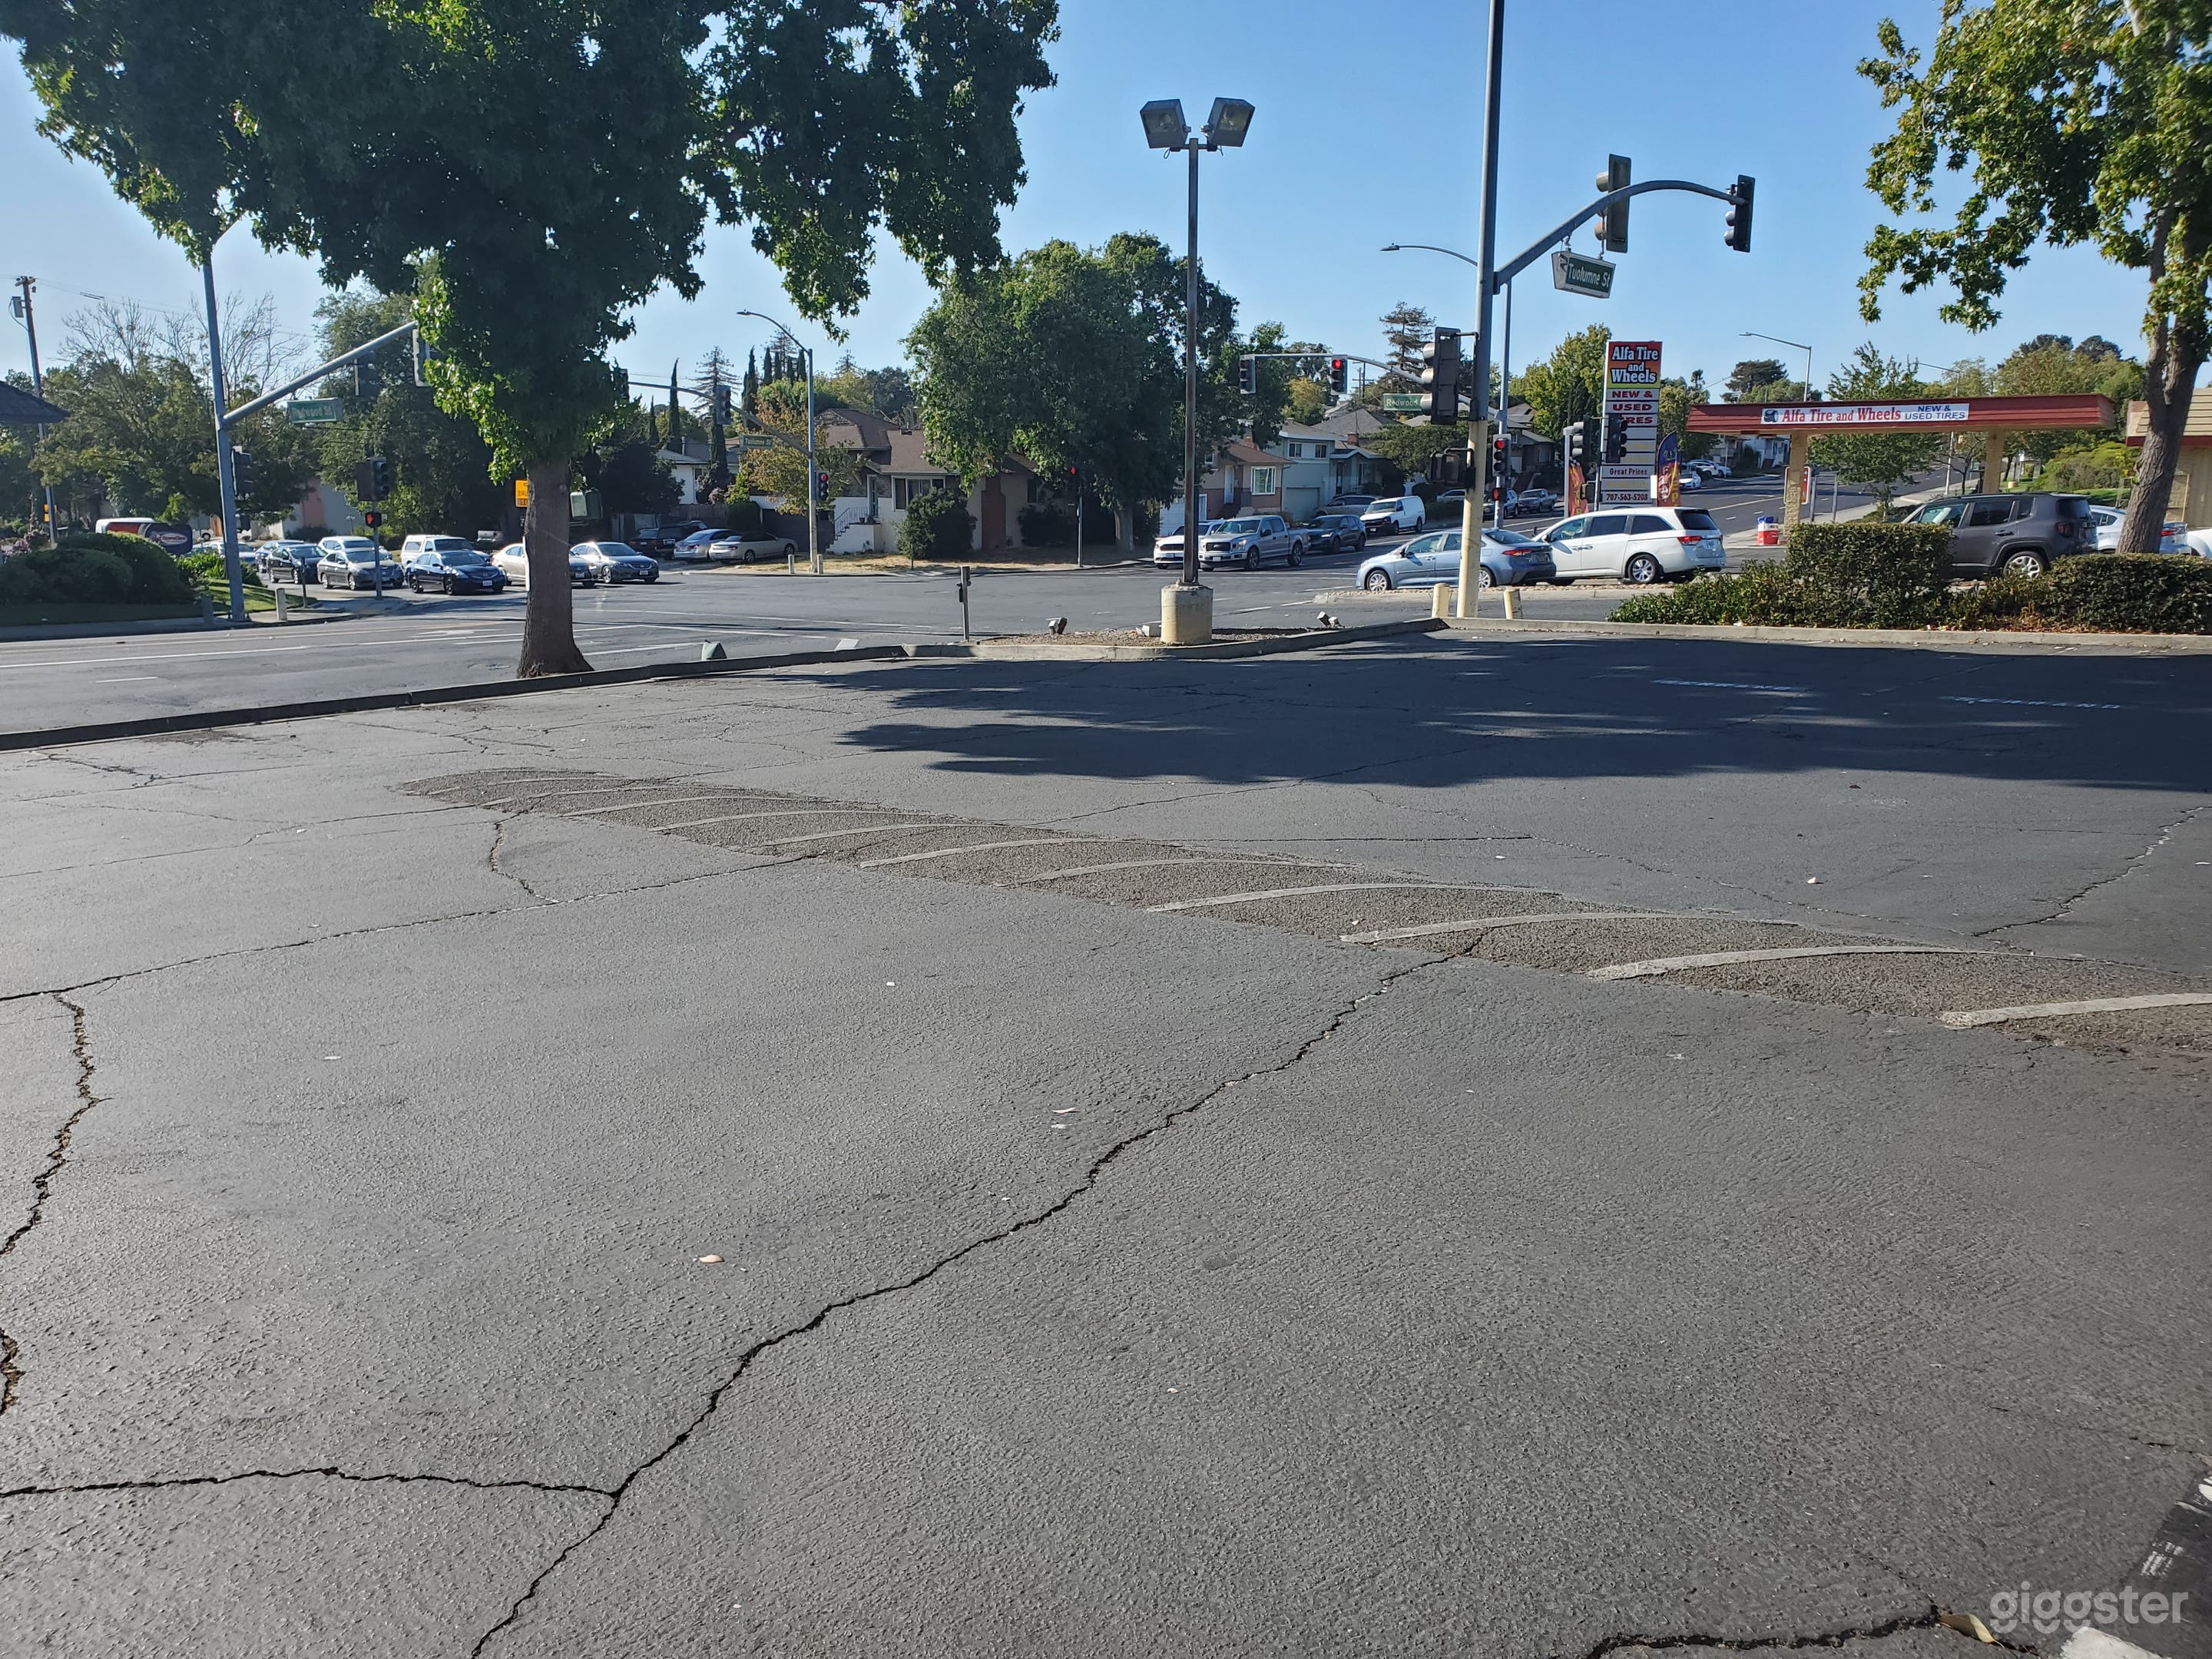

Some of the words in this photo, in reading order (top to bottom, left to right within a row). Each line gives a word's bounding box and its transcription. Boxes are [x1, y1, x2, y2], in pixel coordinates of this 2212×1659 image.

[1568, 263, 1601, 286] Tuolumne
[1601, 271, 1611, 288] St
[1611, 346, 1635, 361] Alfa
[1636, 346, 1658, 361] Tire
[1628, 362, 1644, 372] and
[1611, 369, 1657, 383] Wheels
[1782, 409, 1806, 422] Alfa
[1809, 409, 1833, 422] Tire
[1836, 409, 1854, 422] and
[1857, 407, 1901, 421] Wheels
